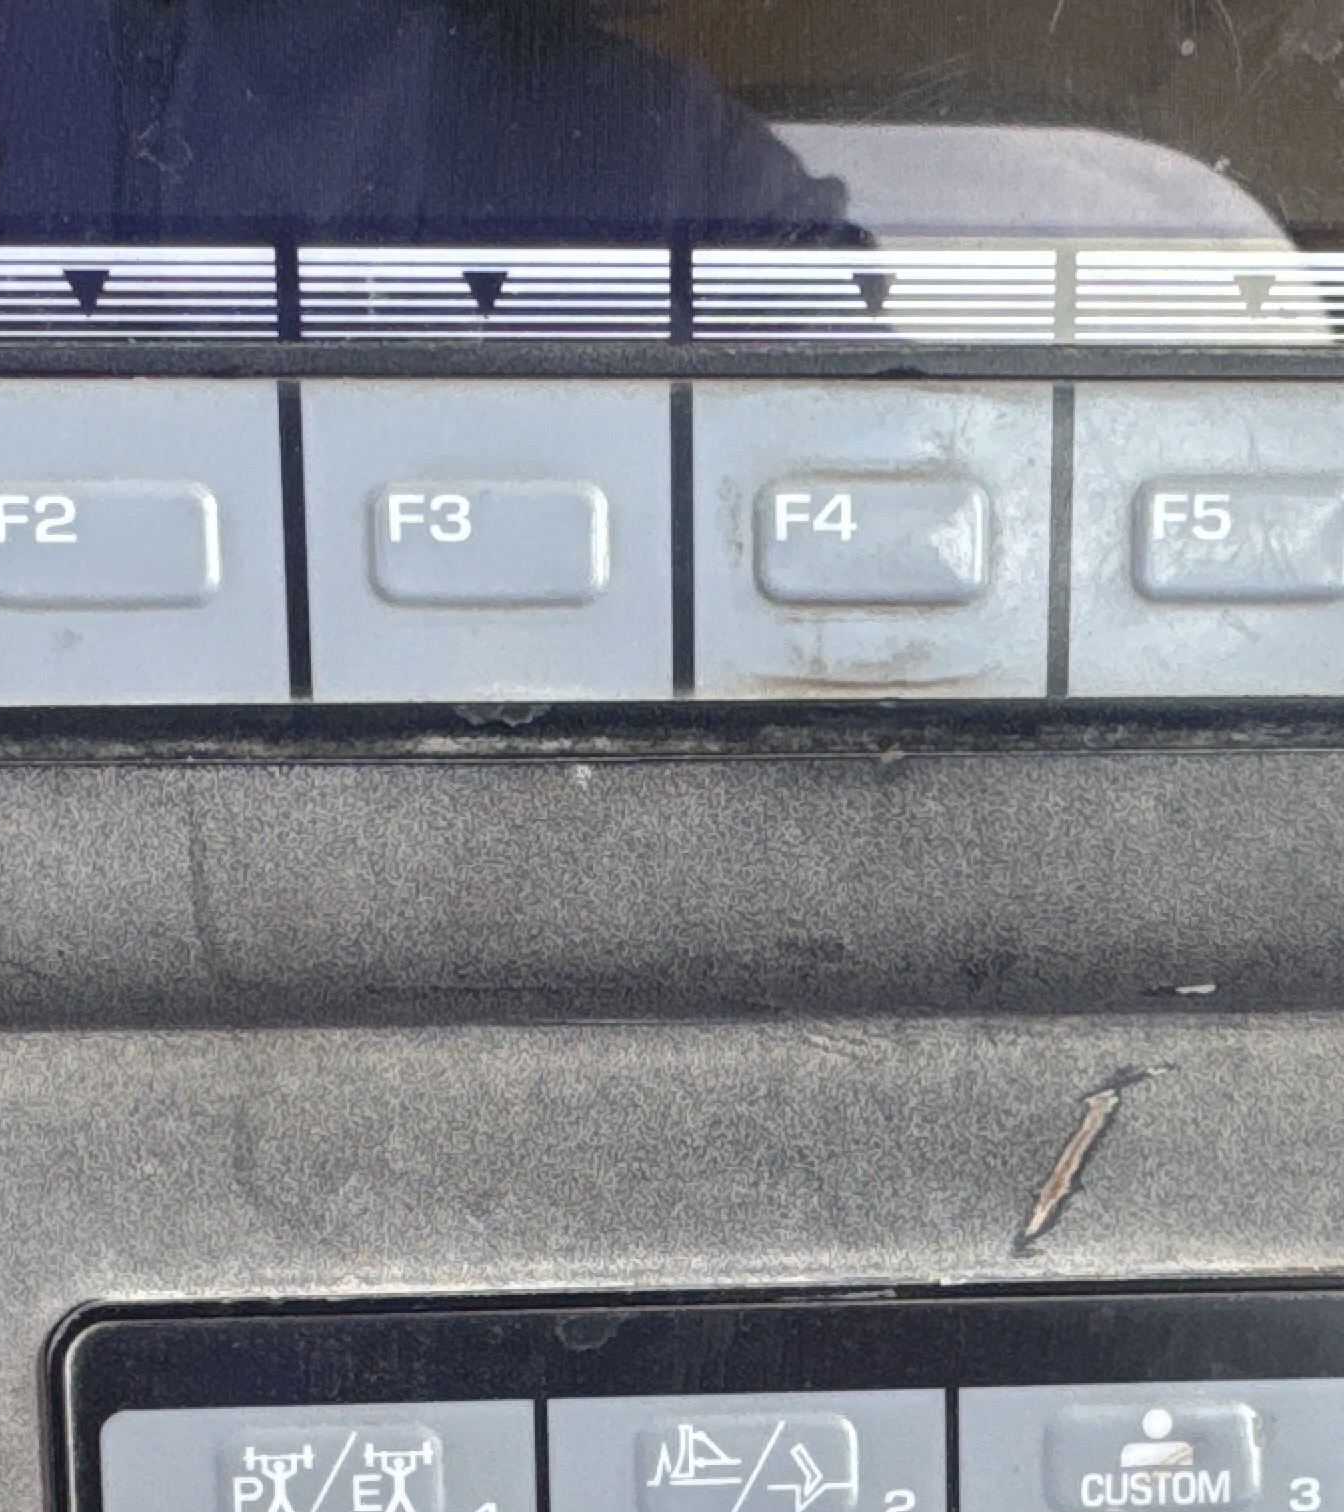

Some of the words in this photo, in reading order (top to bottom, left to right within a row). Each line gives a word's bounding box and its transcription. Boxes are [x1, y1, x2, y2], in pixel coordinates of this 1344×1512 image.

[388, 494, 472, 542] F3
[776, 494, 858, 540] F4
[1152, 494, 1232, 540] F5
[1080, 1470, 1230, 1508] CUSTOM
[1289, 1476, 1322, 1512] 3
